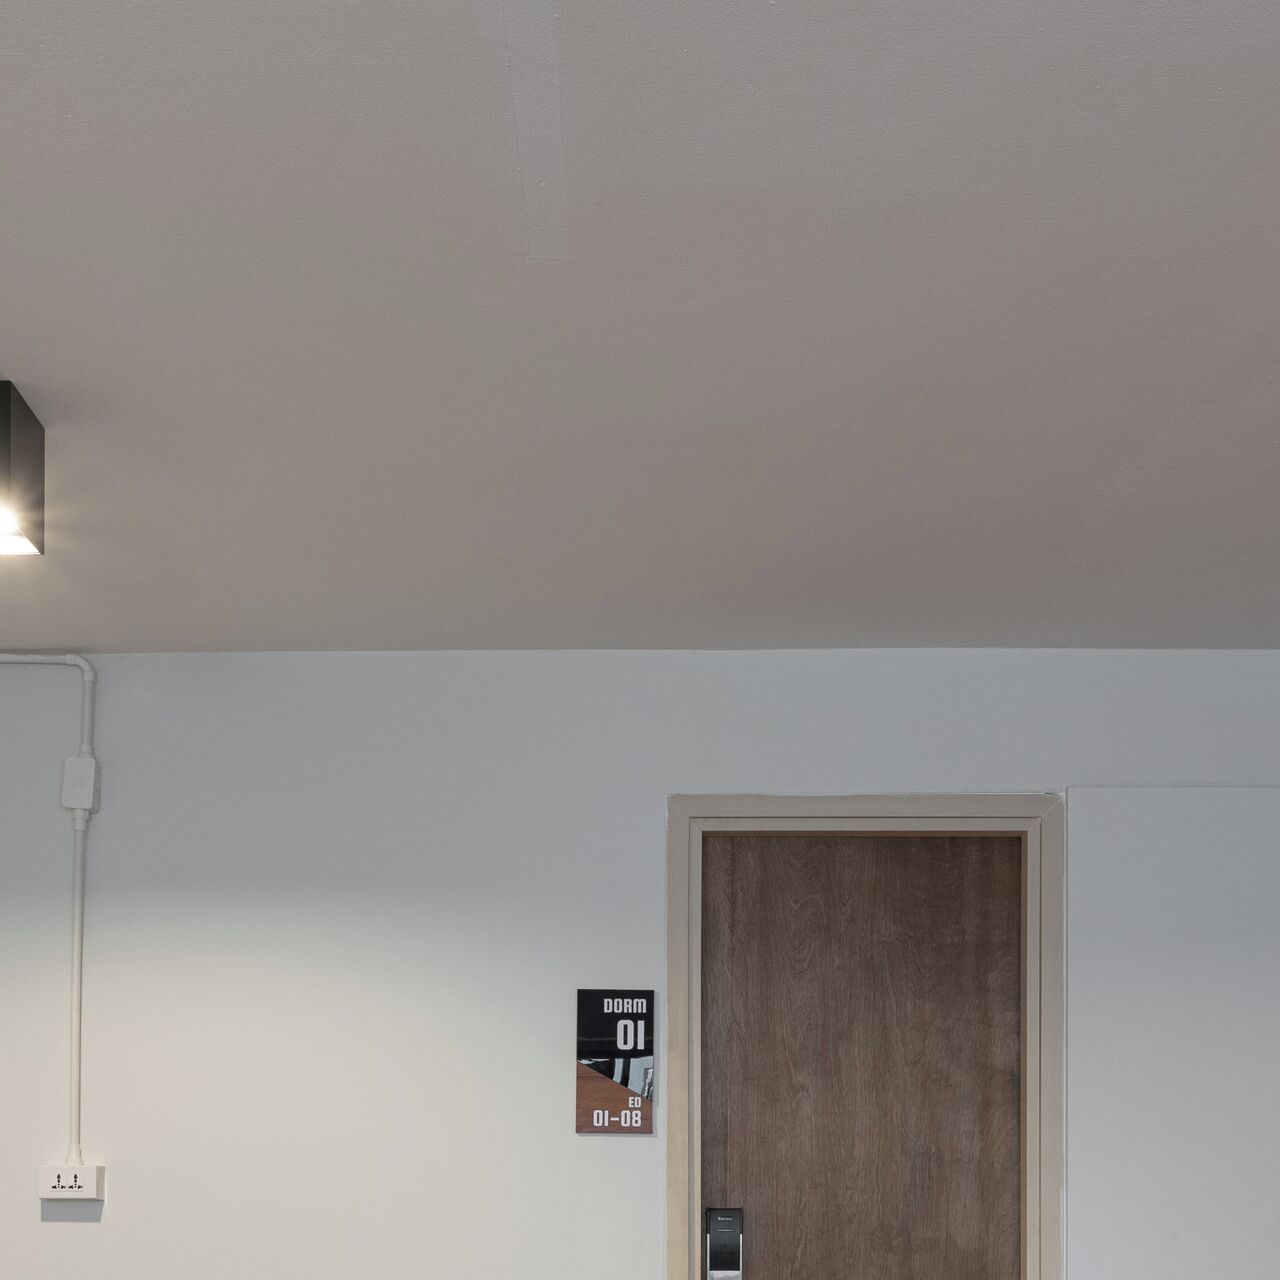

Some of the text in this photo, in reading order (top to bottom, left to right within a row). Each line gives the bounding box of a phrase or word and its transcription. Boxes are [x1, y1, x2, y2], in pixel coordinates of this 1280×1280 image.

[603, 998, 647, 1014] DORM
[616, 1019, 645, 1050] 01
[628, 1096, 642, 1108] ED
[592, 1109, 642, 1127] 01-08
